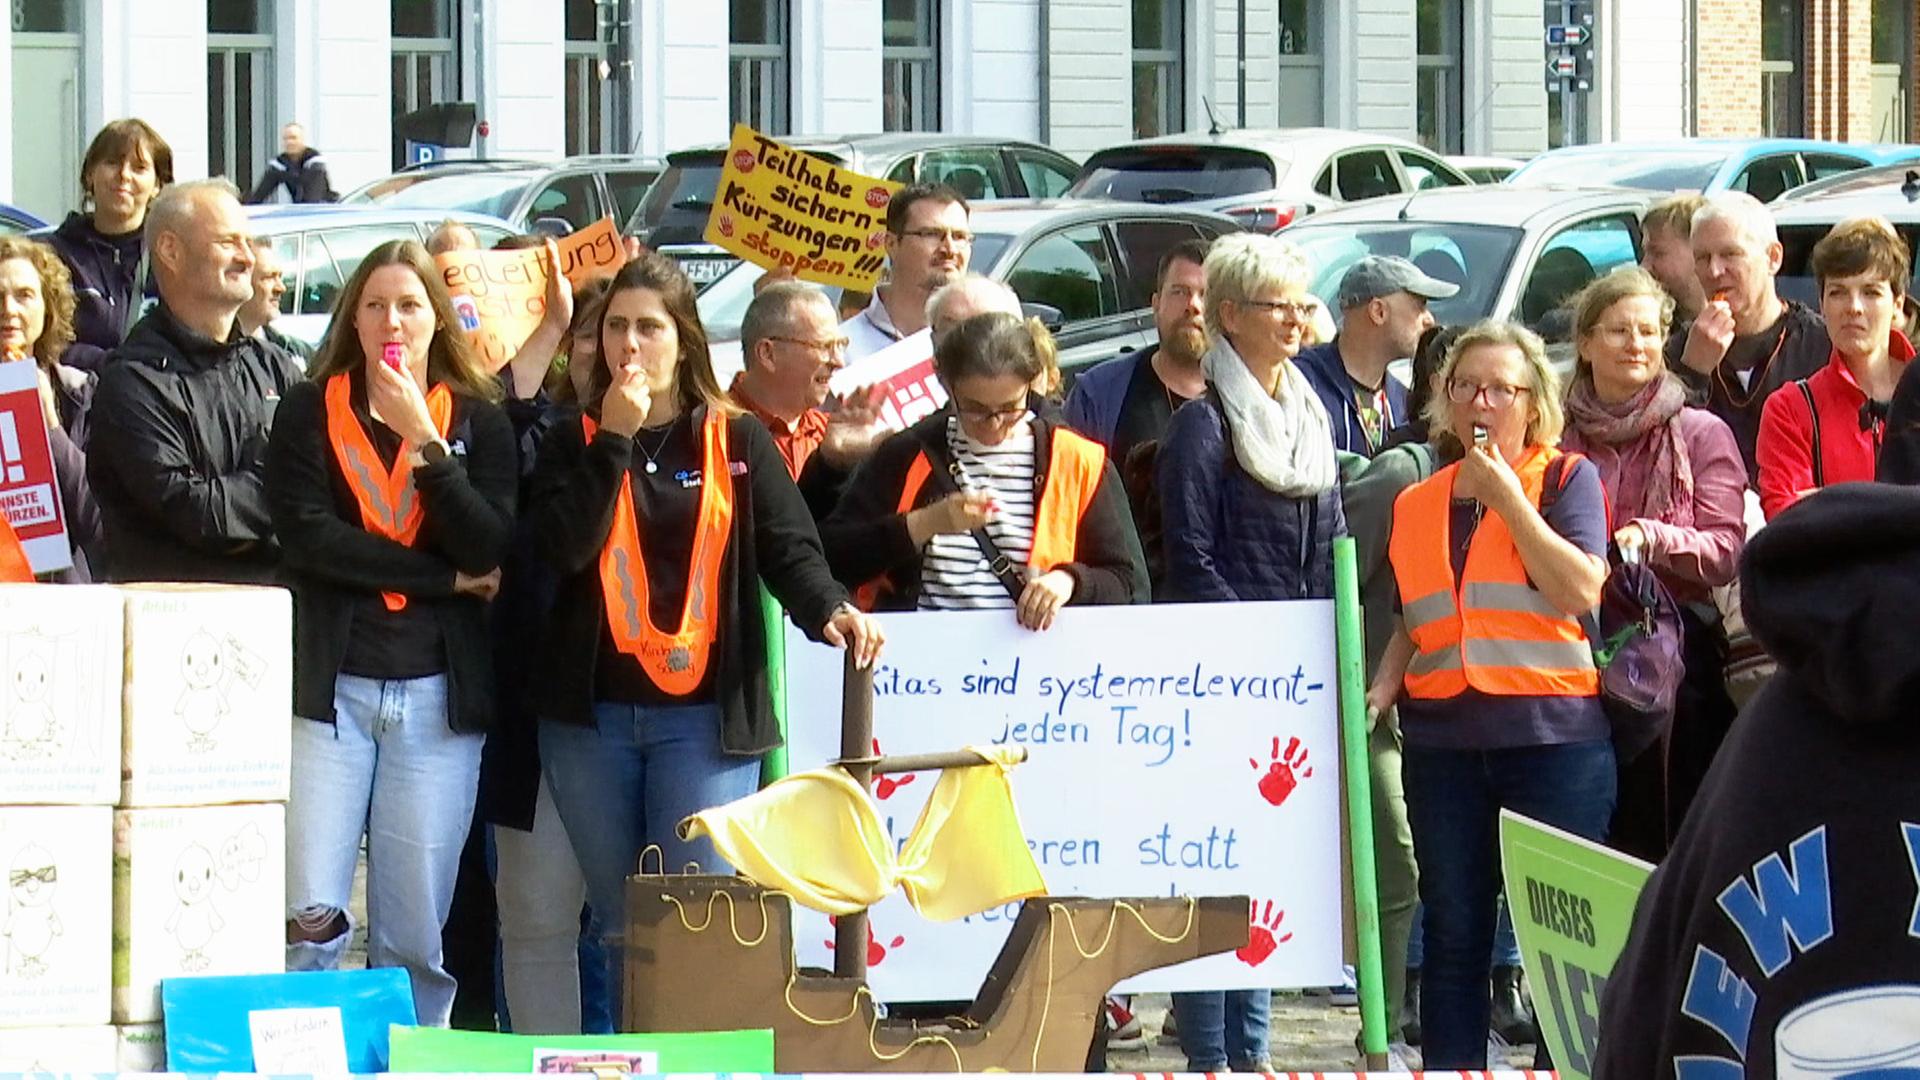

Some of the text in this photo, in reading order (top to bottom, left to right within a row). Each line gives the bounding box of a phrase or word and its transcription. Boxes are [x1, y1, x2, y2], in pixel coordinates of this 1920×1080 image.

[420, 147, 433, 163] P
[753, 135, 853, 198] Teilhabe
[723, 180, 861, 259] Kürzungen
[961, 656, 1020, 695] sind
[1038, 662, 1324, 716] systemrelevant-
[991, 705, 1192, 768] jeden Tag!
[1138, 821, 1239, 869] statt
[1526, 876, 1596, 948] DIESES
